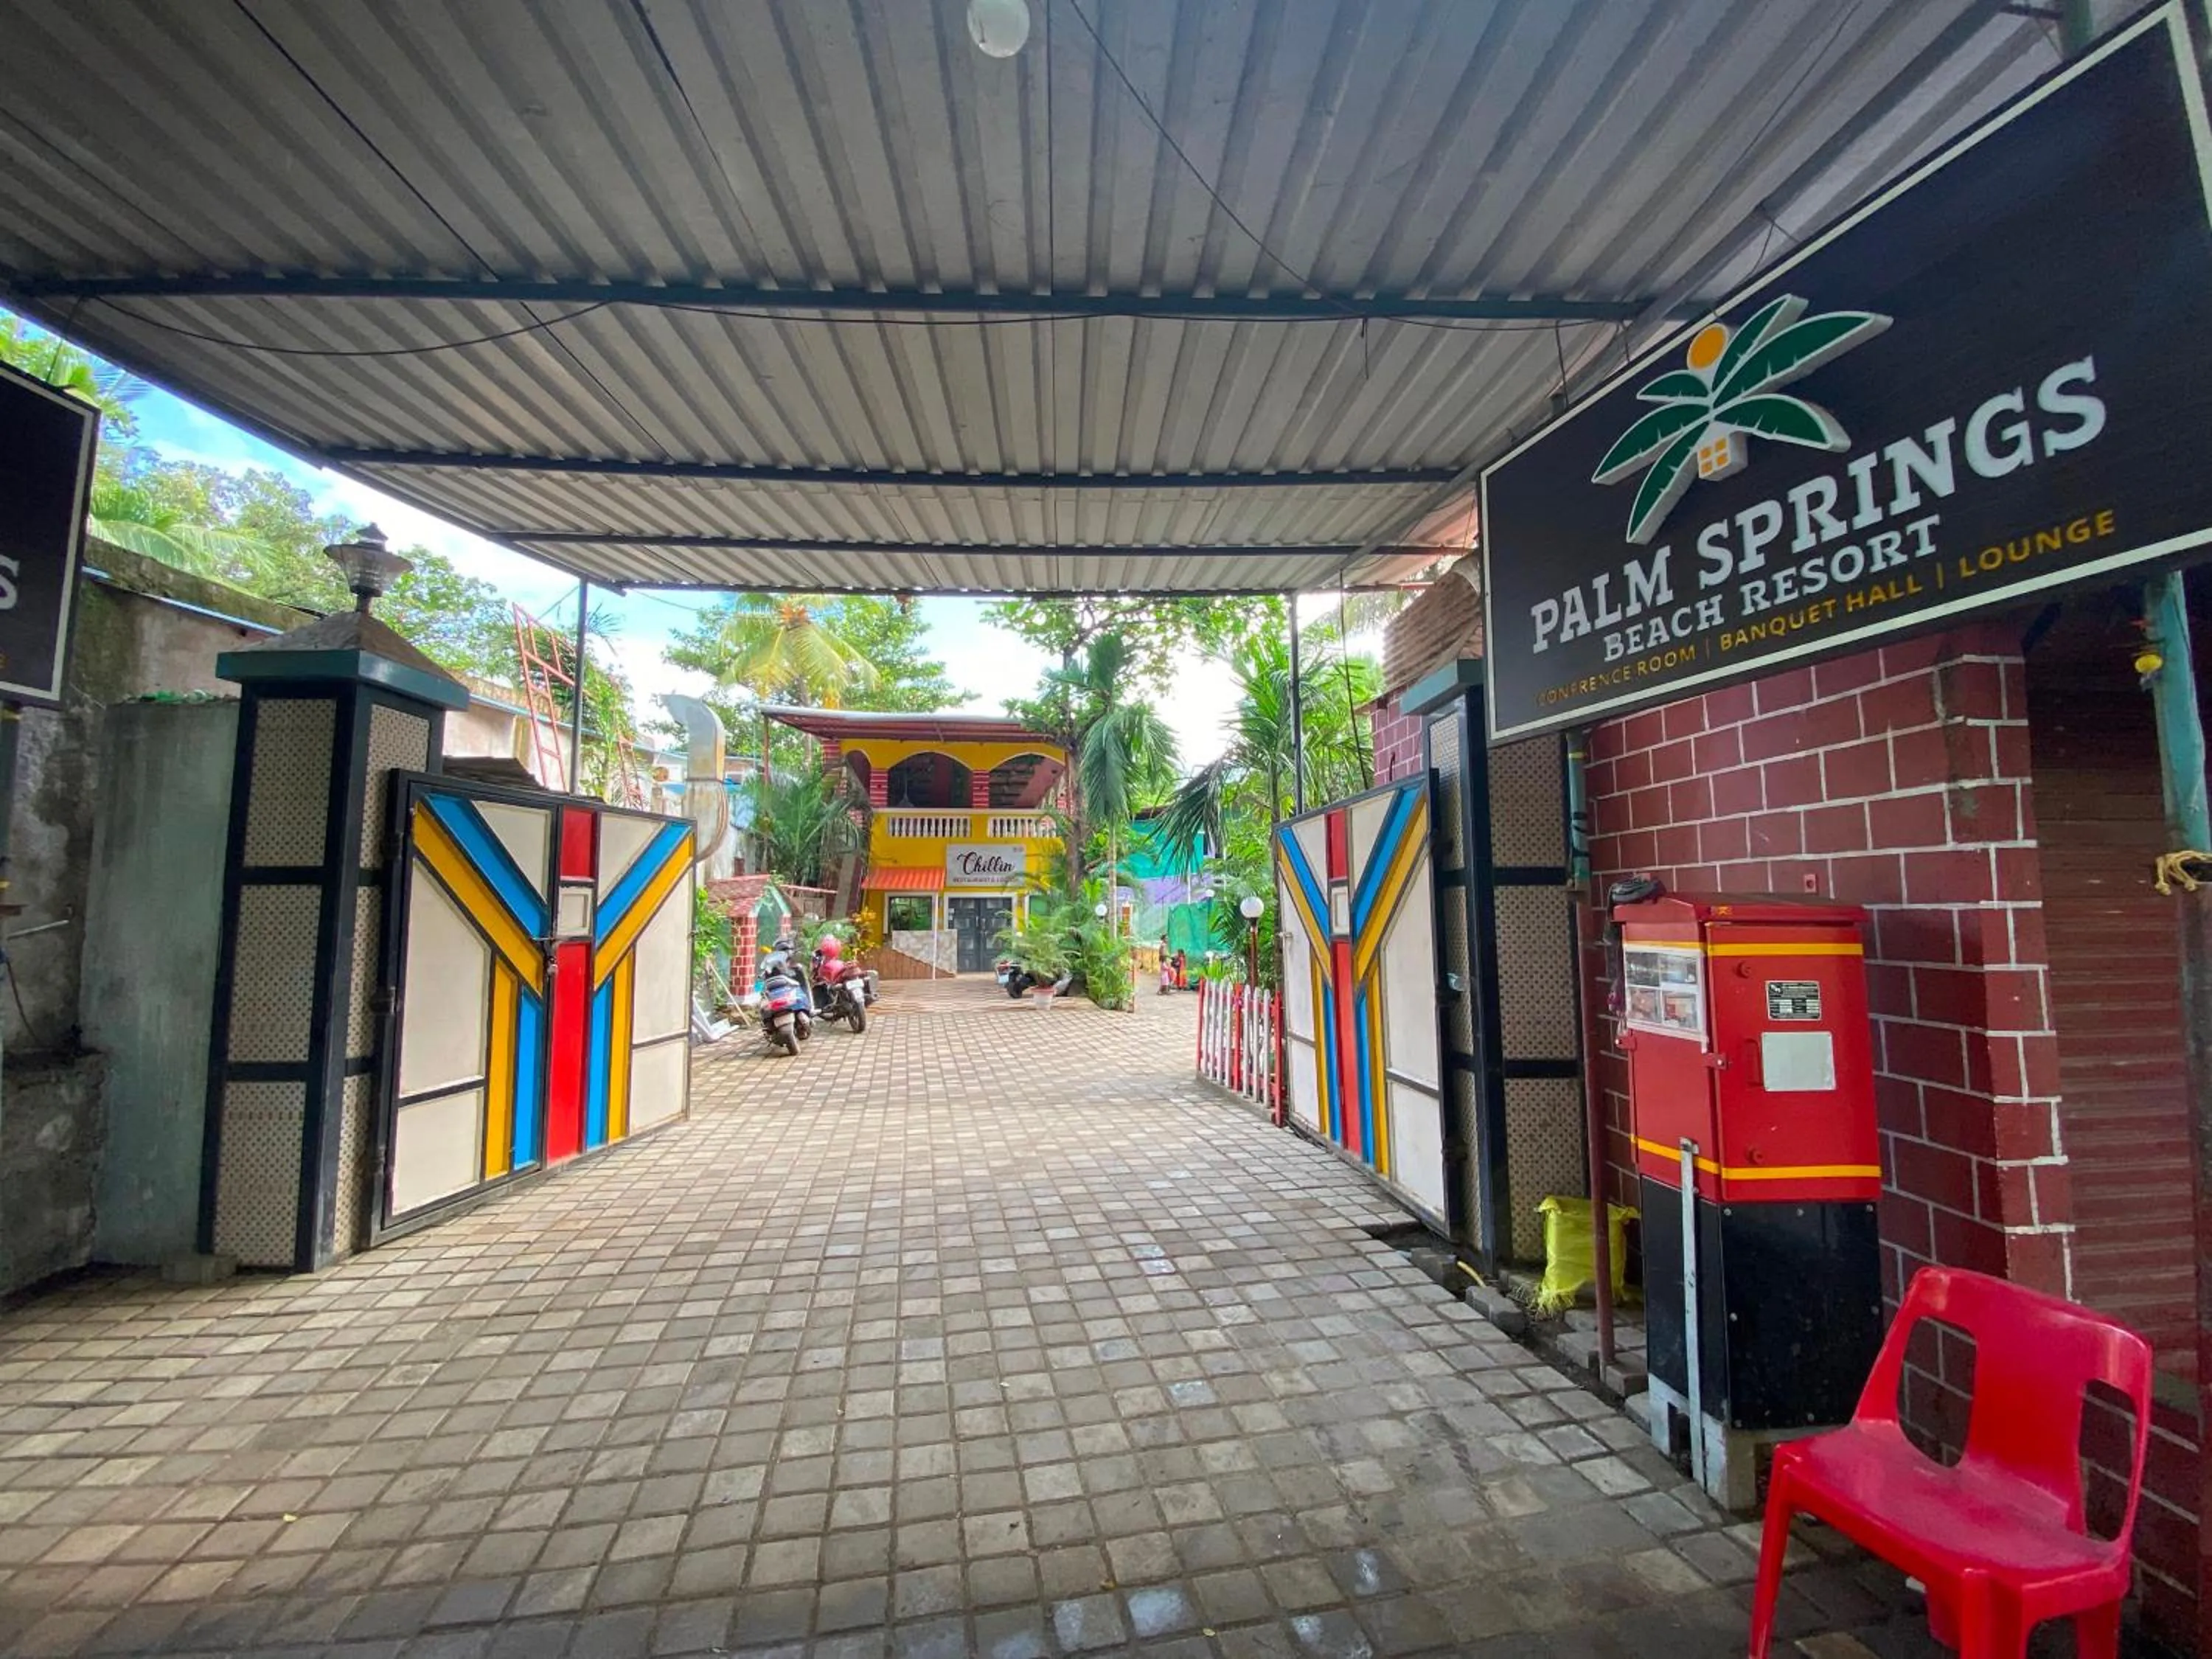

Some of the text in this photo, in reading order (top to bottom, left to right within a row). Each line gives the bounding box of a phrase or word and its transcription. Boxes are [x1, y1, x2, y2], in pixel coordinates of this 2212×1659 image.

[1531, 356, 2107, 654] PALM SPRINGS
[1603, 514, 1941, 662] BEACH RESORT
[1637, 644, 1697, 676] ROOM
[1719, 597, 1837, 652] BANQUET
[1846, 574, 1924, 613] HALL
[1958, 509, 2115, 579] LOUNGE
[956, 851, 1015, 875] Chillin
